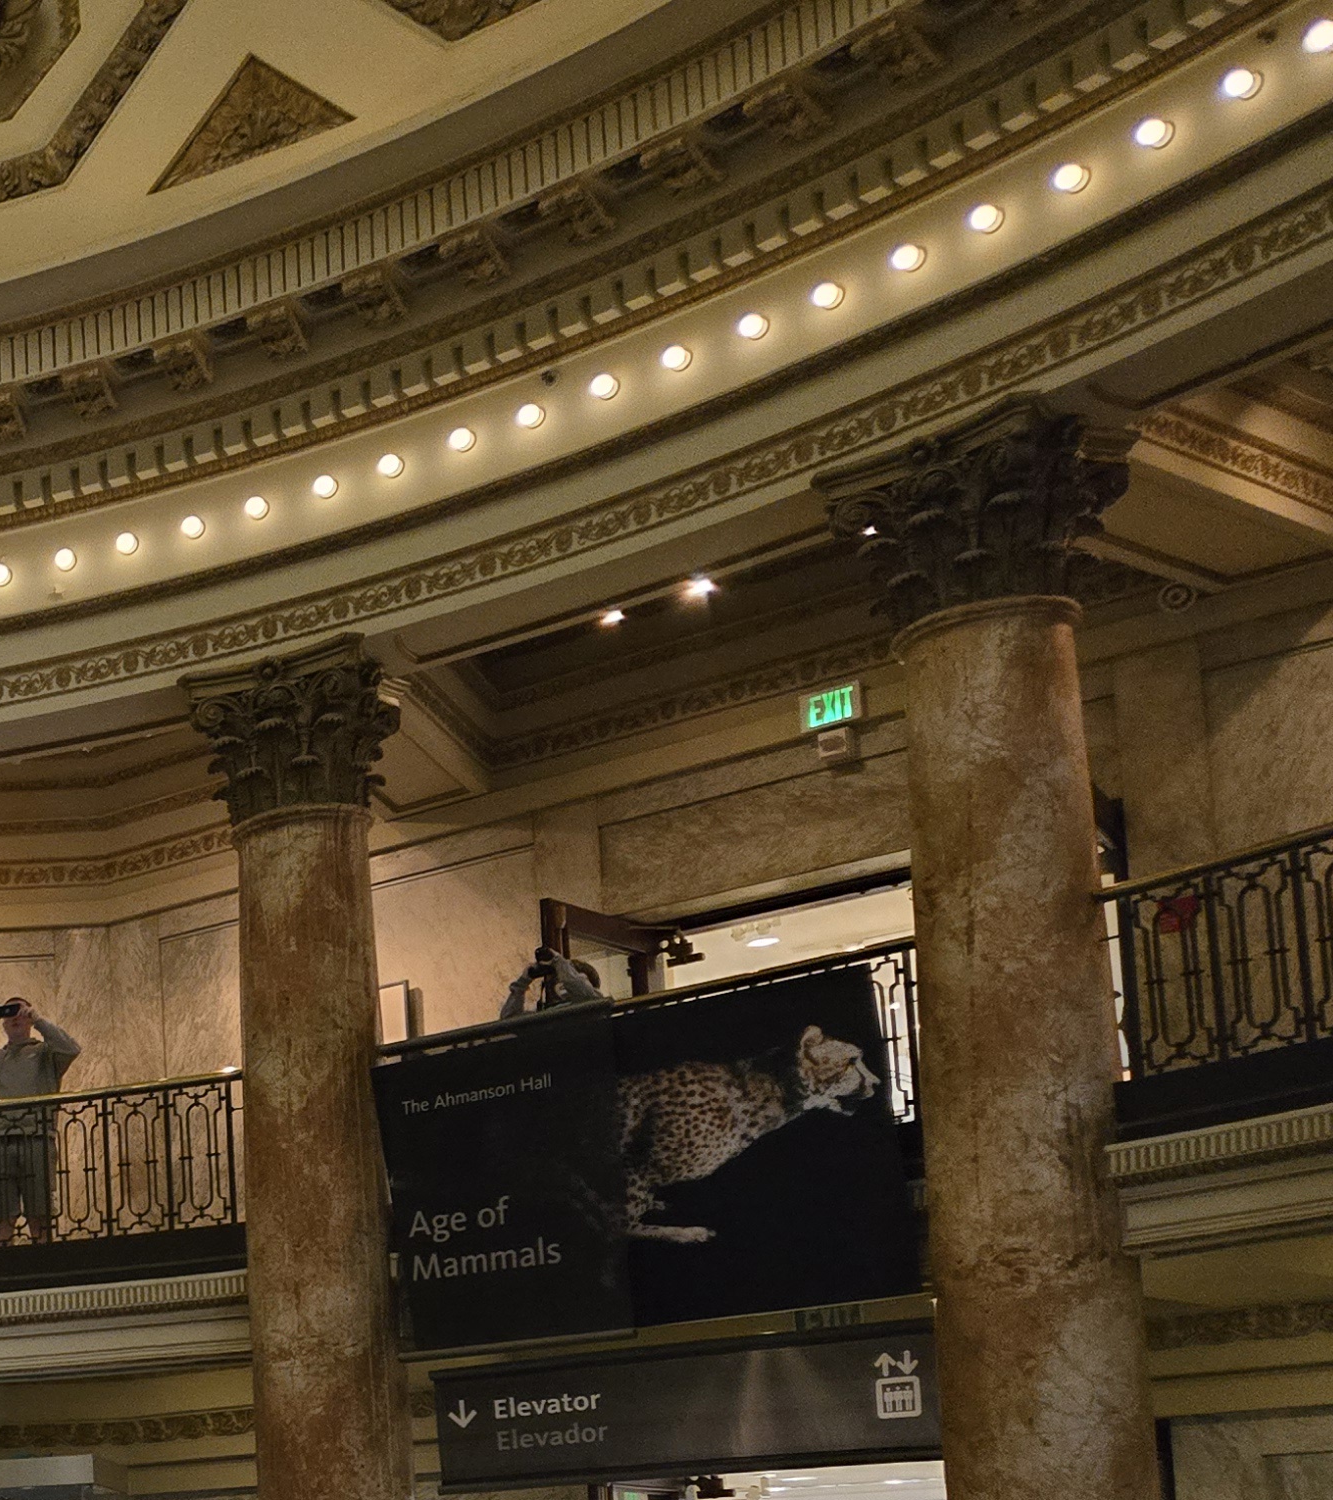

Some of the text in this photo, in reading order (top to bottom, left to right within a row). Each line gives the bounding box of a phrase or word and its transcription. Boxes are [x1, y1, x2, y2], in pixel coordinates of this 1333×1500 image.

[808, 685, 853, 728] EXIT
[401, 1072, 552, 1115] The Ahmanson Hall
[409, 1195, 510, 1243] Age of
[413, 1236, 562, 1282] Mammals
[493, 1393, 601, 1420] Elevator
[496, 1421, 608, 1451] Elevador
